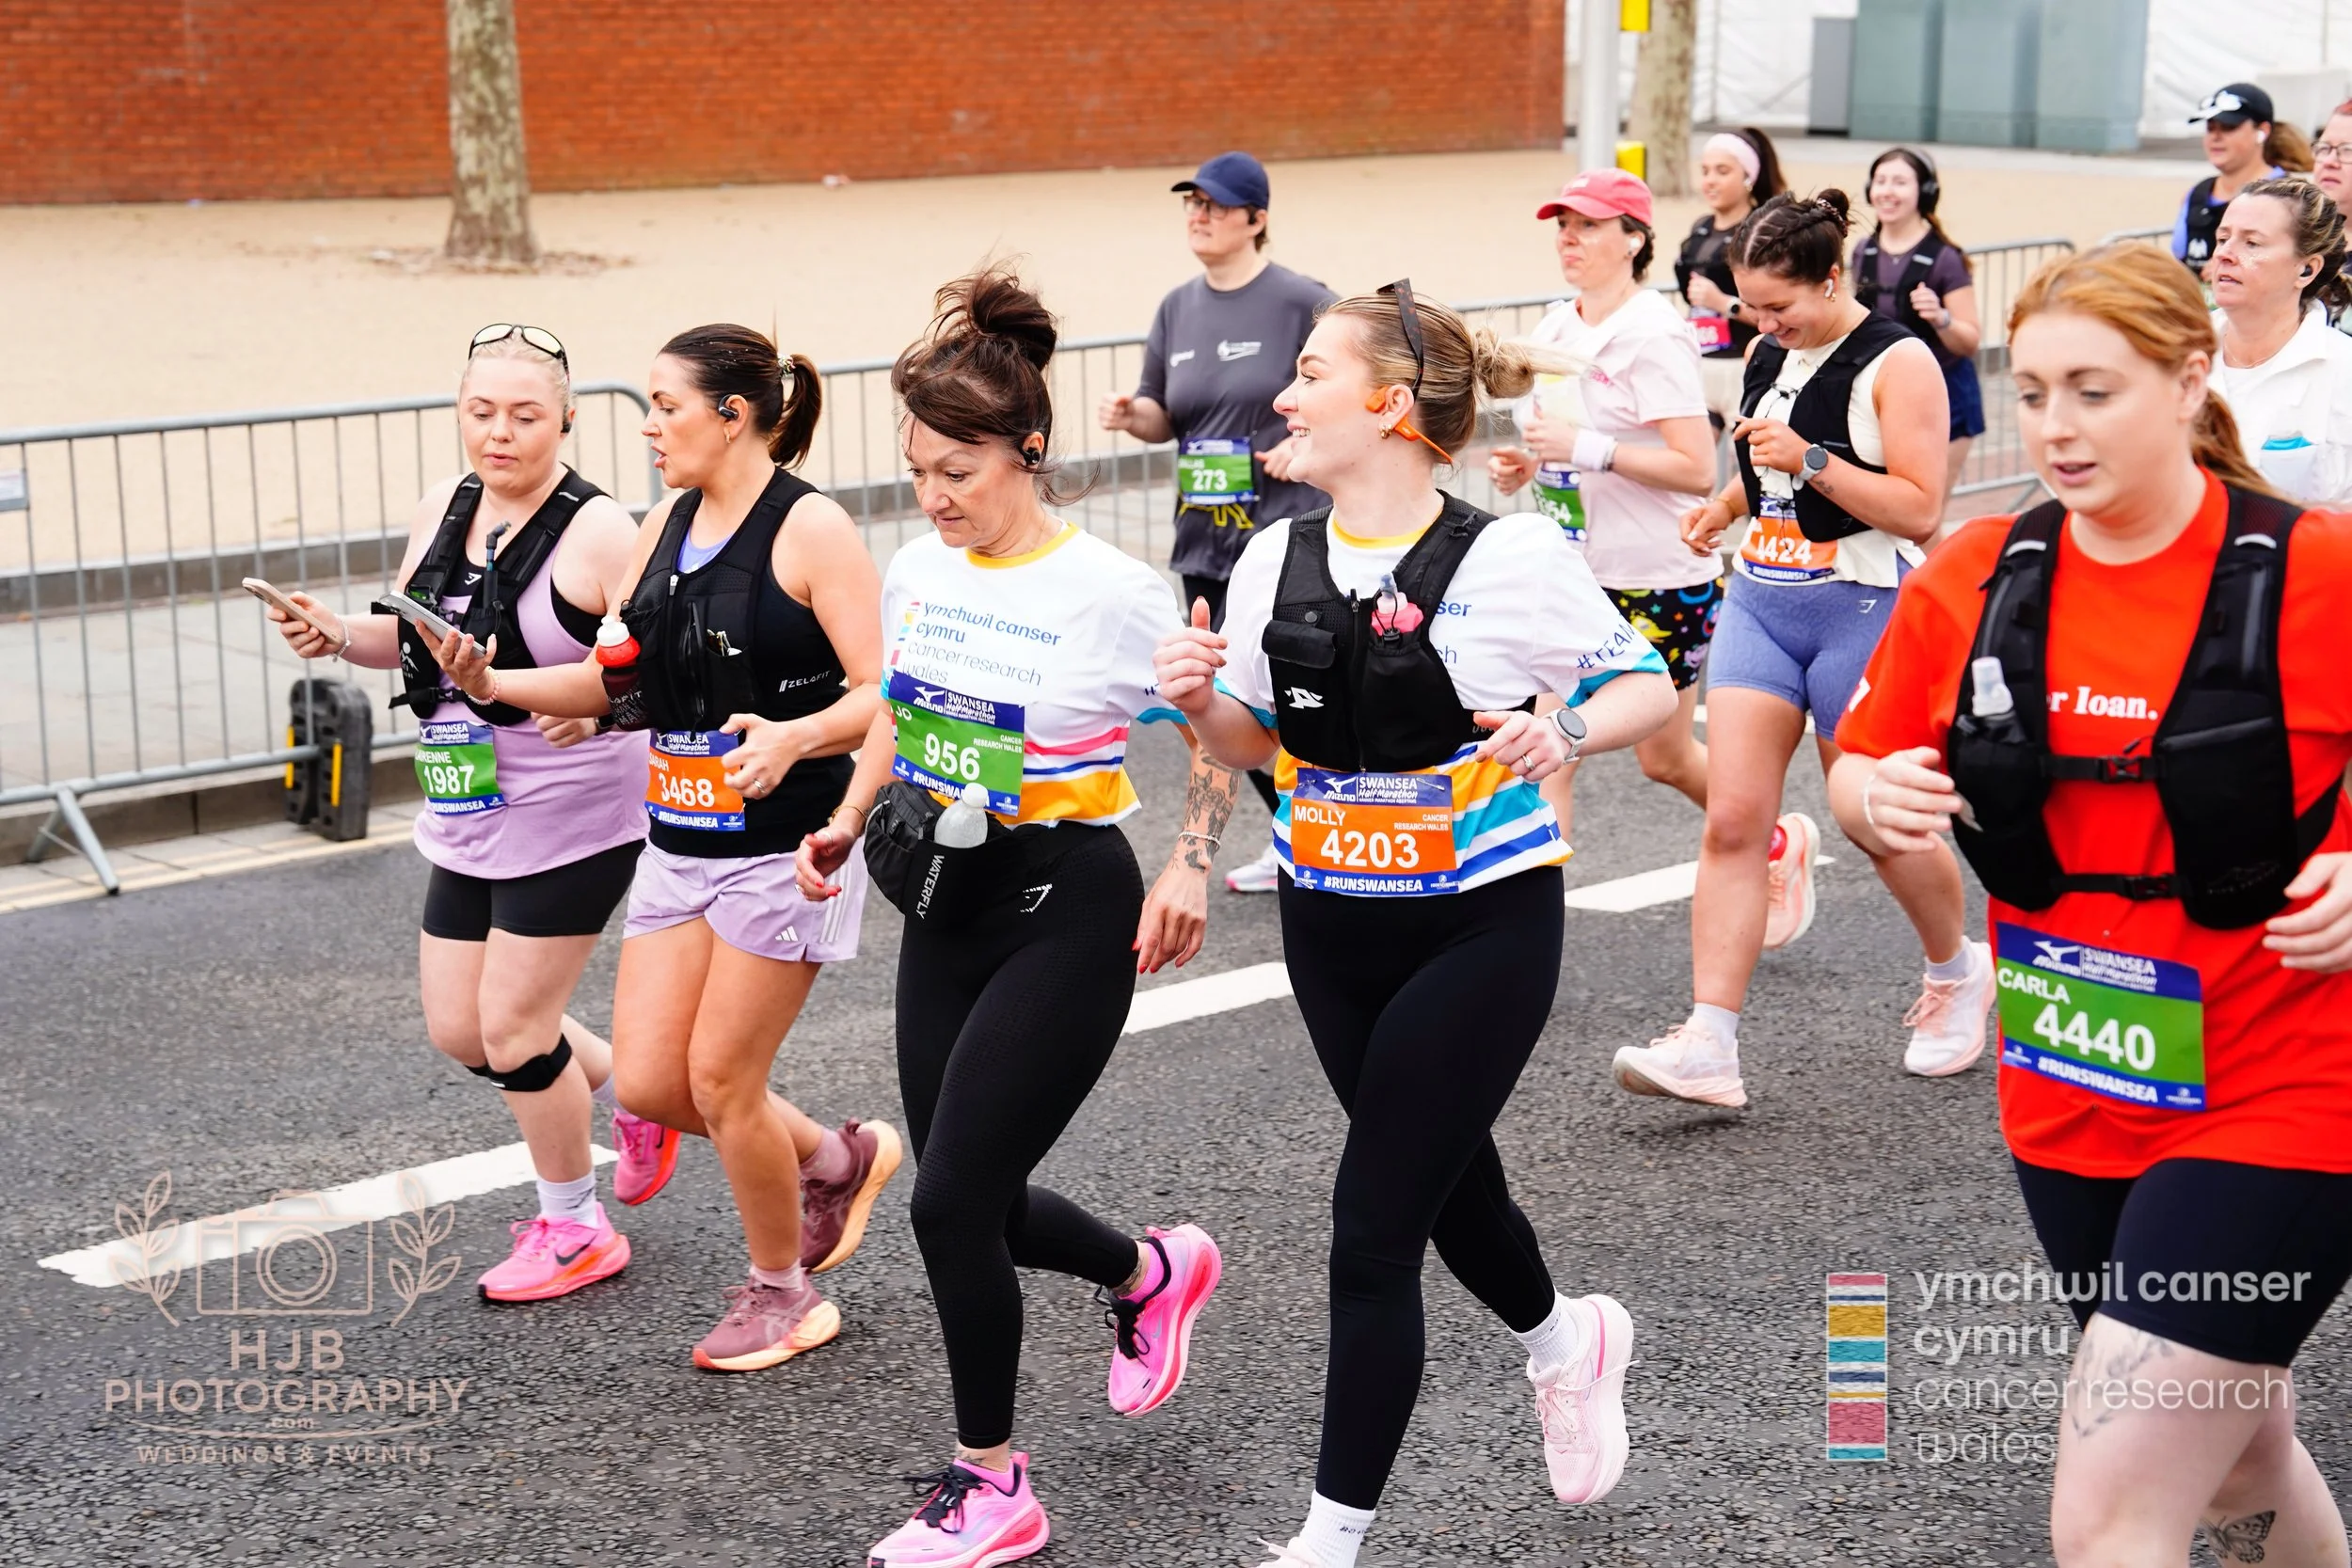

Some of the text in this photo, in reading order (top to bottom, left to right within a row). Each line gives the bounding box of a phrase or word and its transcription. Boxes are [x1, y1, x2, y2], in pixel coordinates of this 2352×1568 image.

[1192, 469, 1228, 491] 273
[1437, 601, 1472, 616] ser
[916, 622, 965, 643] cymru
[923, 602, 1062, 646] ymchwil canser
[901, 661, 948, 684] wales
[908, 641, 1041, 686] cancer research
[896, 705, 913, 721] JO
[948, 692, 995, 714] SWANSEA
[2074, 686, 2158, 721] loan.
[432, 723, 469, 734] SWANSEA
[668, 734, 709, 744] SWANEA
[924, 732, 980, 781] 956
[424, 765, 475, 794] 1987
[659, 772, 715, 808] 3468
[1359, 777, 1418, 789] SWANSEA
[1295, 804, 1347, 827] MOLLY
[1394, 822, 1449, 832] RESEARCH WALES
[1422, 814, 1449, 822] CANCER
[1320, 829, 1420, 869] 4203
[915, 854, 945, 920] WATERFLY
[1324, 875, 1423, 893] #RUNSWANSEA
[2083, 947, 2157, 976] SWANSEA
[1996, 967, 2072, 1005] CARLA
[2032, 1003, 2156, 1071] 4440
[2037, 1055, 2159, 1103] #RUNSWANSEA
